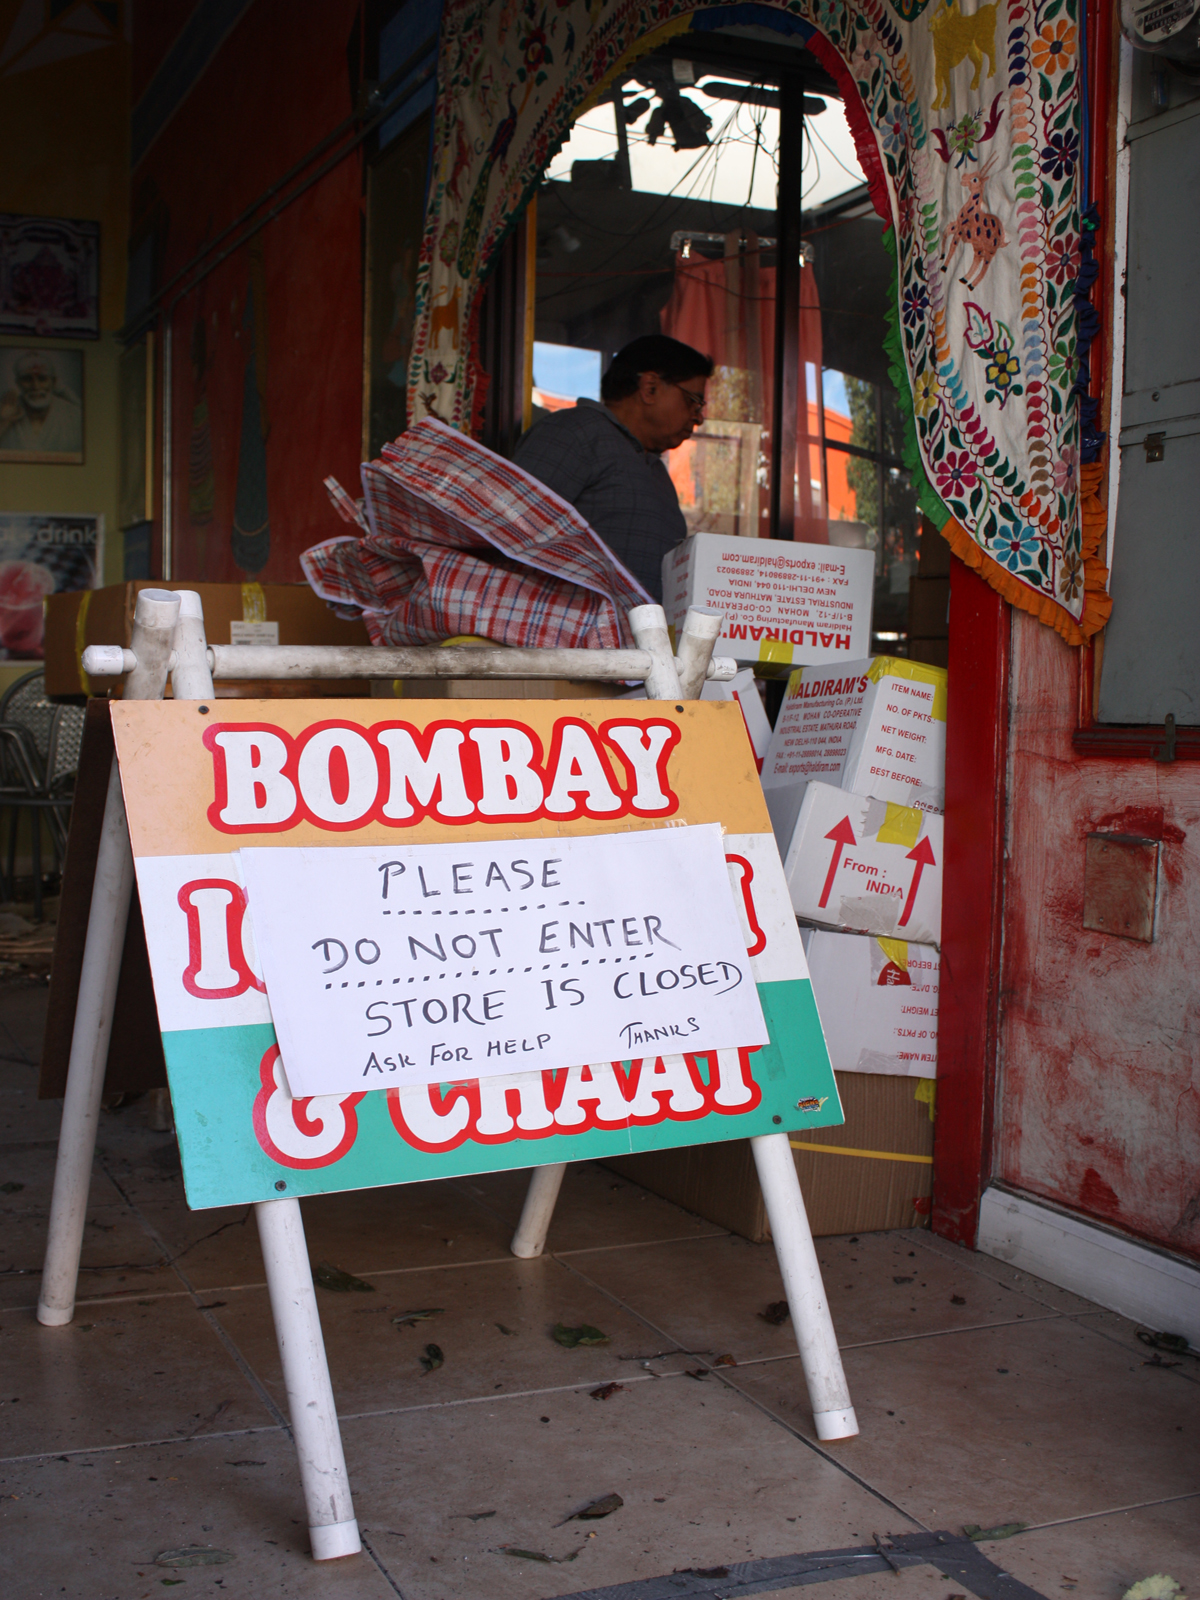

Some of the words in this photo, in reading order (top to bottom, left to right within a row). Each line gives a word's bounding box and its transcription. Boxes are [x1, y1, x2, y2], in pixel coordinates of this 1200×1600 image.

[37, 523, 97, 543] drink
[722, 553, 816, 570] exports@haldiram.com
[716, 566, 755, 576] 28898023
[728, 579, 752, 588] INDIA
[832, 577, 849, 586] FAX
[706, 588, 733, 599] ROAD,
[772, 584, 815, 594] DELHI-110
[816, 588, 836, 596] NEW
[734, 591, 773, 602] MATHURA
[774, 594, 806, 605] ESTATE,
[706, 600, 772, 613] CO-OPERATIVE
[809, 598, 854, 610] INDUSTRIAL
[742, 613, 754, 622] Co.
[778, 607, 809, 617] MOHAN
[756, 615, 814, 628] Manufacturing
[816, 621, 852, 632] Haldiram
[719, 623, 851, 650] HALDIRAM'
[787, 675, 869, 700] HALDIRAM'S
[891, 683, 910, 694] ITEM
[910, 687, 934, 701] NAME:
[803, 699, 835, 709] Manufacturing
[886, 704, 900, 714] NO.
[901, 708, 912, 716] OF
[803, 712, 820, 720] MOHAN
[823, 708, 862, 719] CO-OPERATIVE
[828, 736, 842, 744] INDIA
[881, 725, 896, 735] NET
[898, 729, 927, 744] WEIGHT:
[875, 745, 893, 756] MFG.
[895, 750, 917, 763] DATE:
[203, 717, 681, 834] BOMBAY
[870, 766, 890, 778] BEST
[891, 772, 923, 787] BEFORE:
[843, 857, 879, 876] From
[378, 858, 562, 899] PLEASE
[866, 879, 903, 900] INDIA
[312, 937, 381, 974] DO
[408, 928, 503, 962] NOT
[539, 915, 682, 953] ENTER
[365, 990, 506, 1037] STORE
[541, 978, 585, 1010] IS
[613, 961, 743, 999] CLOSED
[900, 1005, 930, 1015] WEIGHT:
[918, 1030, 927, 1038] OF
[487, 1033, 551, 1057] HELP
[896, 1051, 921, 1061] NAME:
[921, 1053, 937, 1062] ITEM
[252, 1043, 367, 1170] &
